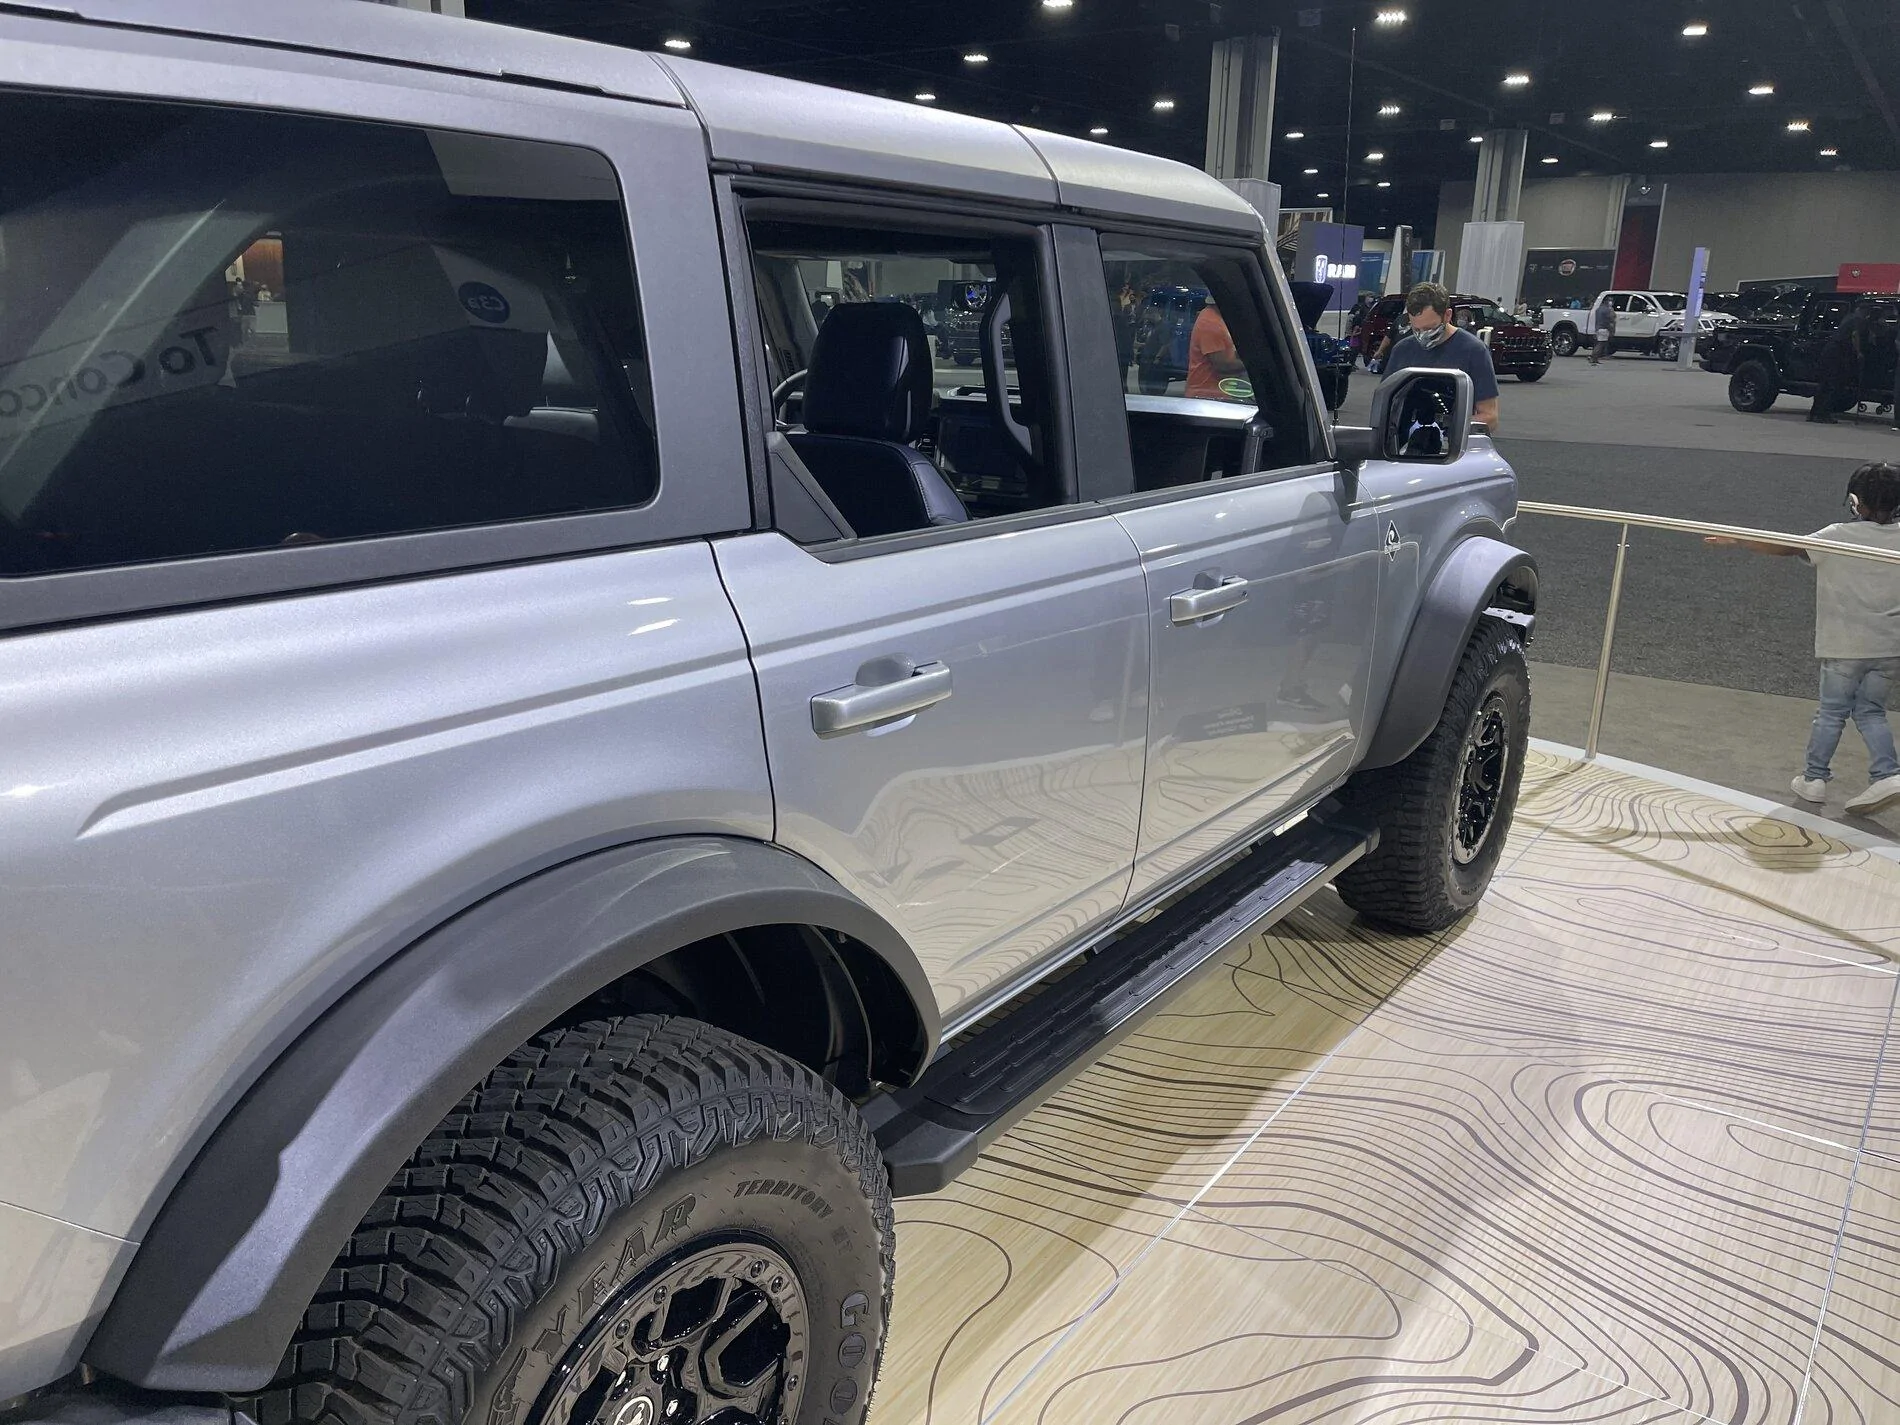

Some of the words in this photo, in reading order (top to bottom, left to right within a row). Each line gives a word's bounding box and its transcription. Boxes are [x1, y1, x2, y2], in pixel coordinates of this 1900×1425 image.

[1327, 263, 1357, 279] RAM
[733, 1179, 834, 1220] TERRITORY
[823, 1290, 870, 1425] GOO
